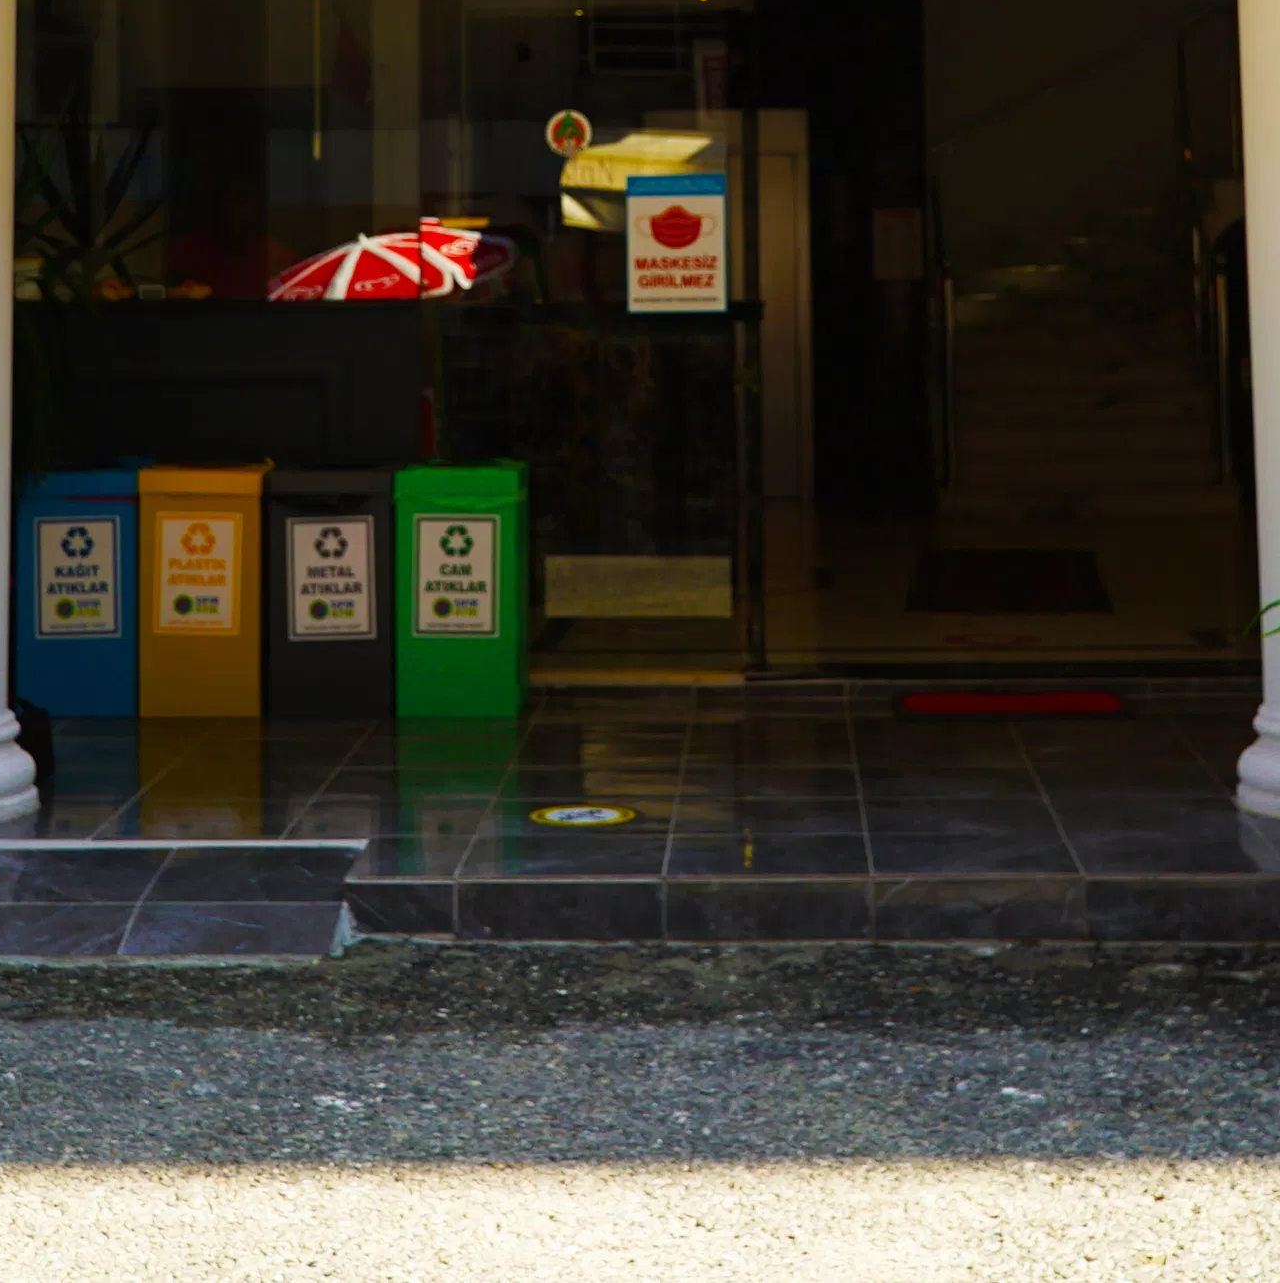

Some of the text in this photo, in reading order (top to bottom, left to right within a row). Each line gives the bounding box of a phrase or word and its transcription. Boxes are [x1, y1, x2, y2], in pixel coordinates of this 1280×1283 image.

[634, 254, 717, 271] MASKESİZ
[637, 271, 715, 289] GİRİLMEZ
[54, 562, 100, 578] KAĞIT
[306, 564, 355, 578] METAL
[439, 563, 473, 576] CAM
[47, 581, 109, 595] ATIKLAR
[300, 581, 363, 595] ATIKLAR
[424, 580, 488, 594] ATIKLAR
